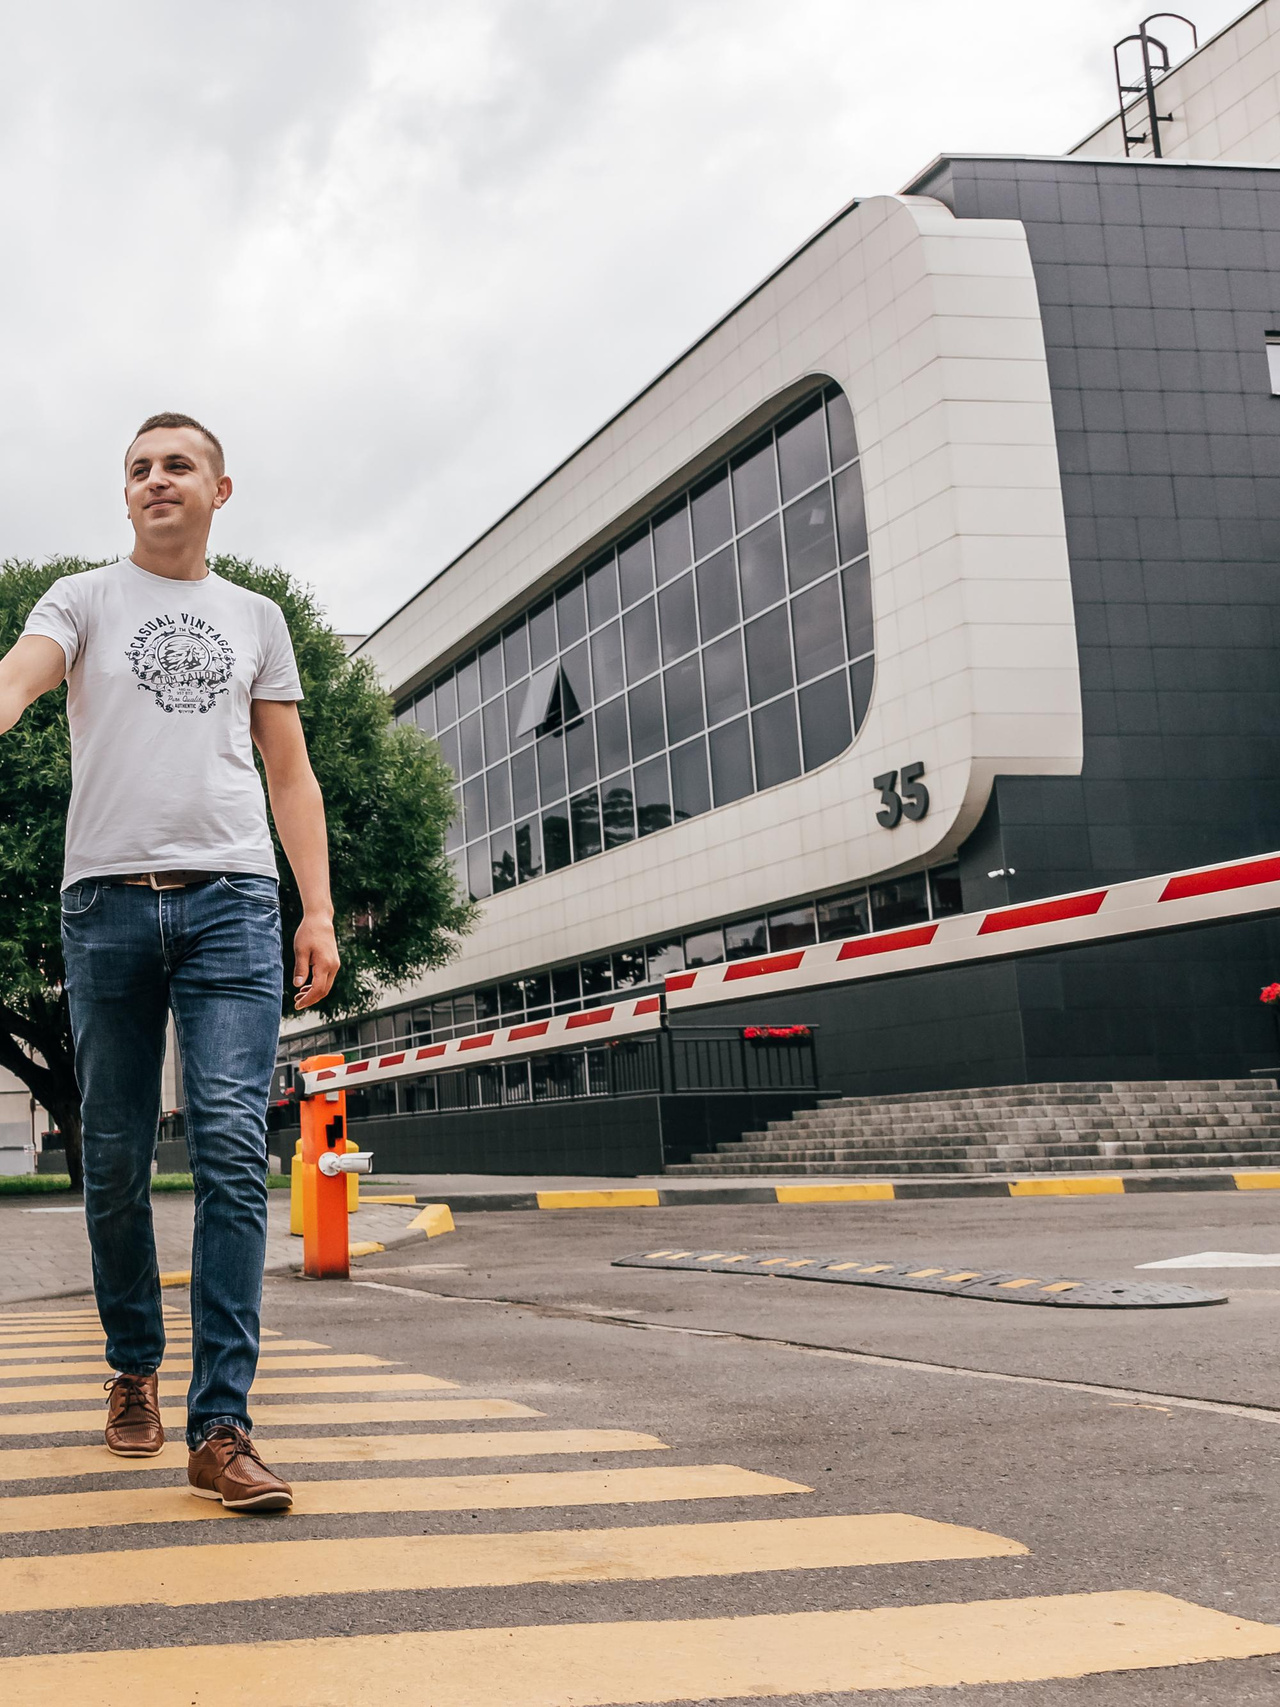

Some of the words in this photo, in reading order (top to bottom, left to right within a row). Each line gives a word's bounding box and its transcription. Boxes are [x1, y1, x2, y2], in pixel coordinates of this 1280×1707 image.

[130, 614, 175, 649] CASUAL
[181, 613, 234, 654] VINTAGE
[157, 674, 178, 684] TOM
[181, 671, 217, 681] TAILOR
[182, 695, 205, 703] Quality
[873, 761, 929, 830] 35
